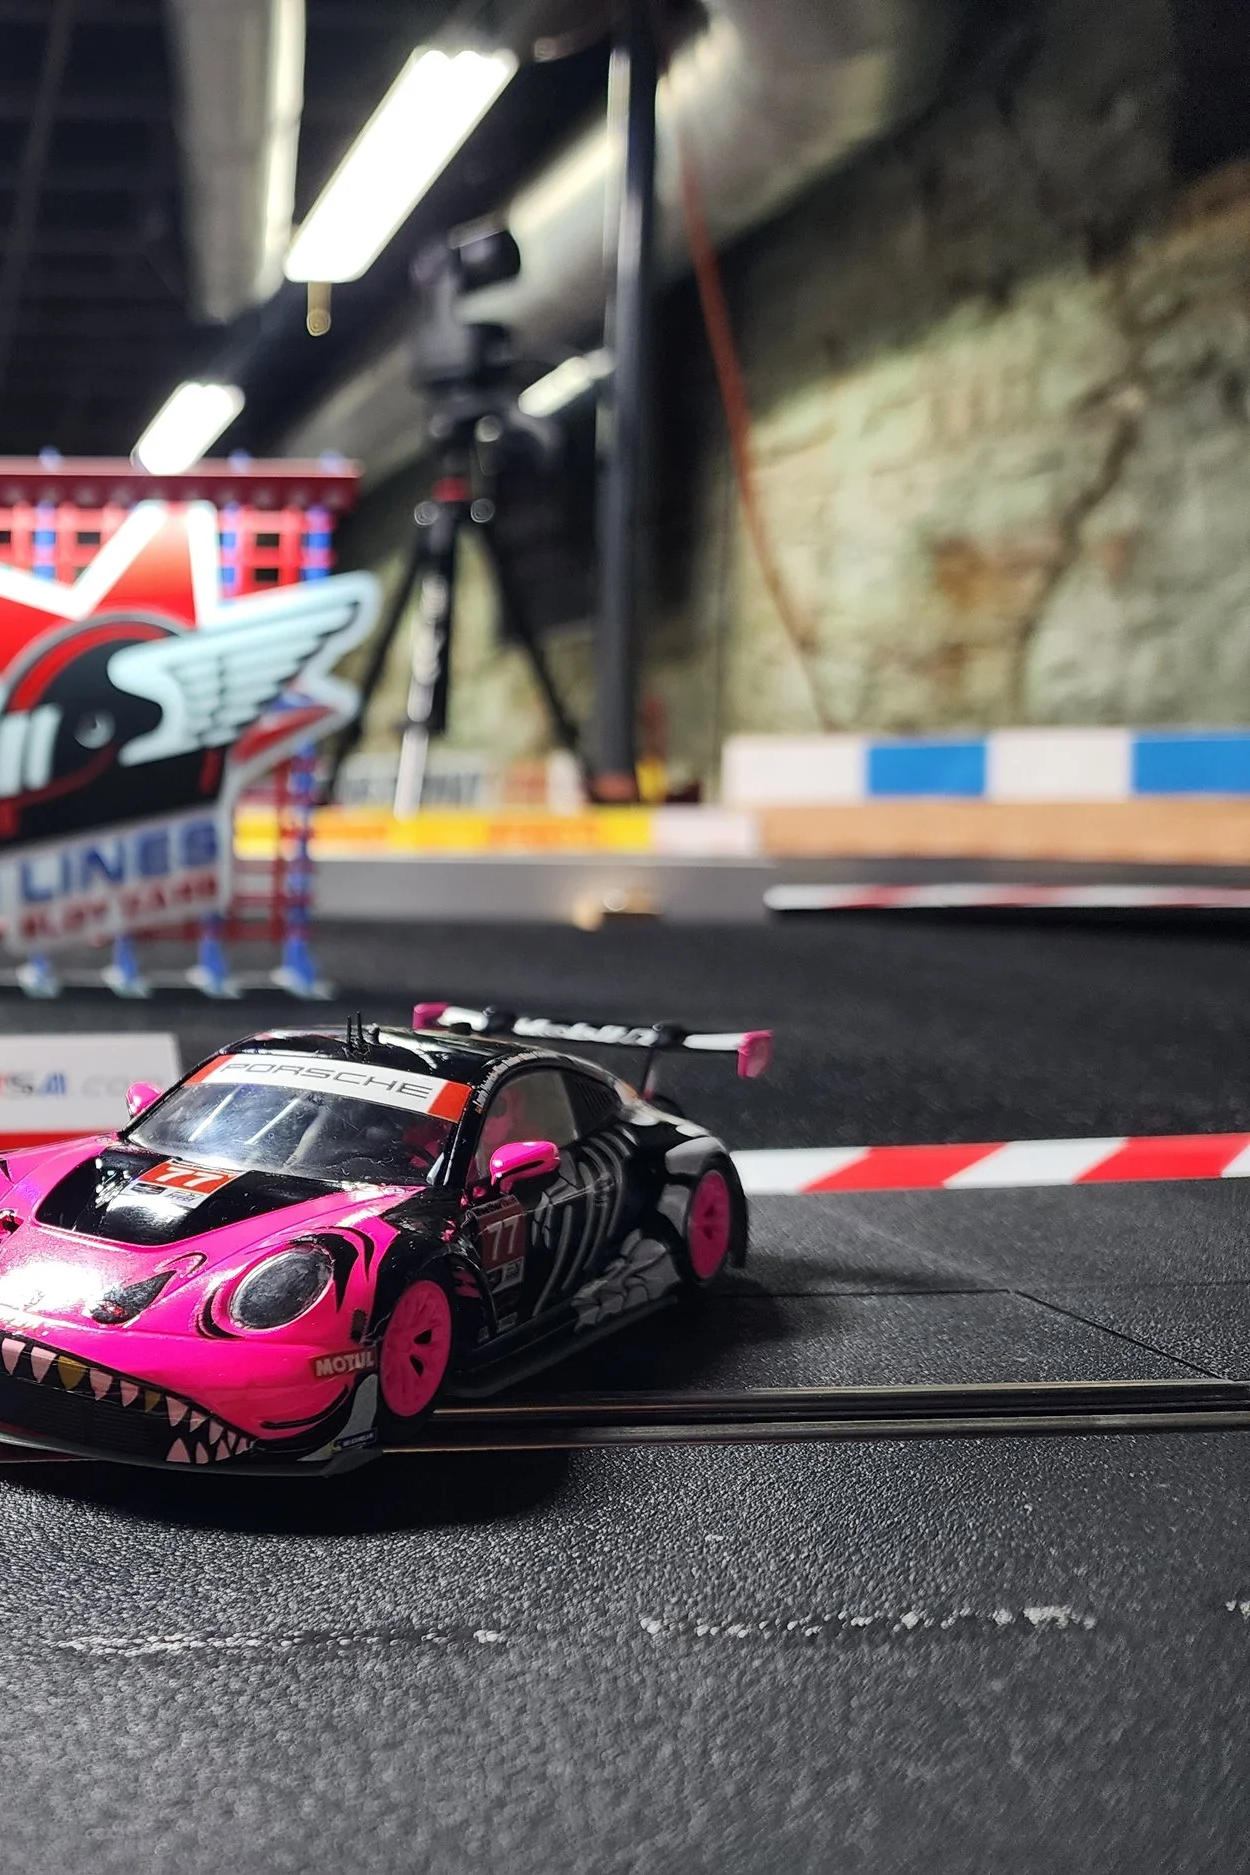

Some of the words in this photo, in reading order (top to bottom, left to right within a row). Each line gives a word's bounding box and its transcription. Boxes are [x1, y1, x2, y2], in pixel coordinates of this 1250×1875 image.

[20, 818, 220, 902] LINES
[220, 1063, 433, 1099] PORSCHE
[155, 1165, 225, 1188] 77
[487, 1216, 519, 1261] 77
[315, 1350, 375, 1377] MOTUL
